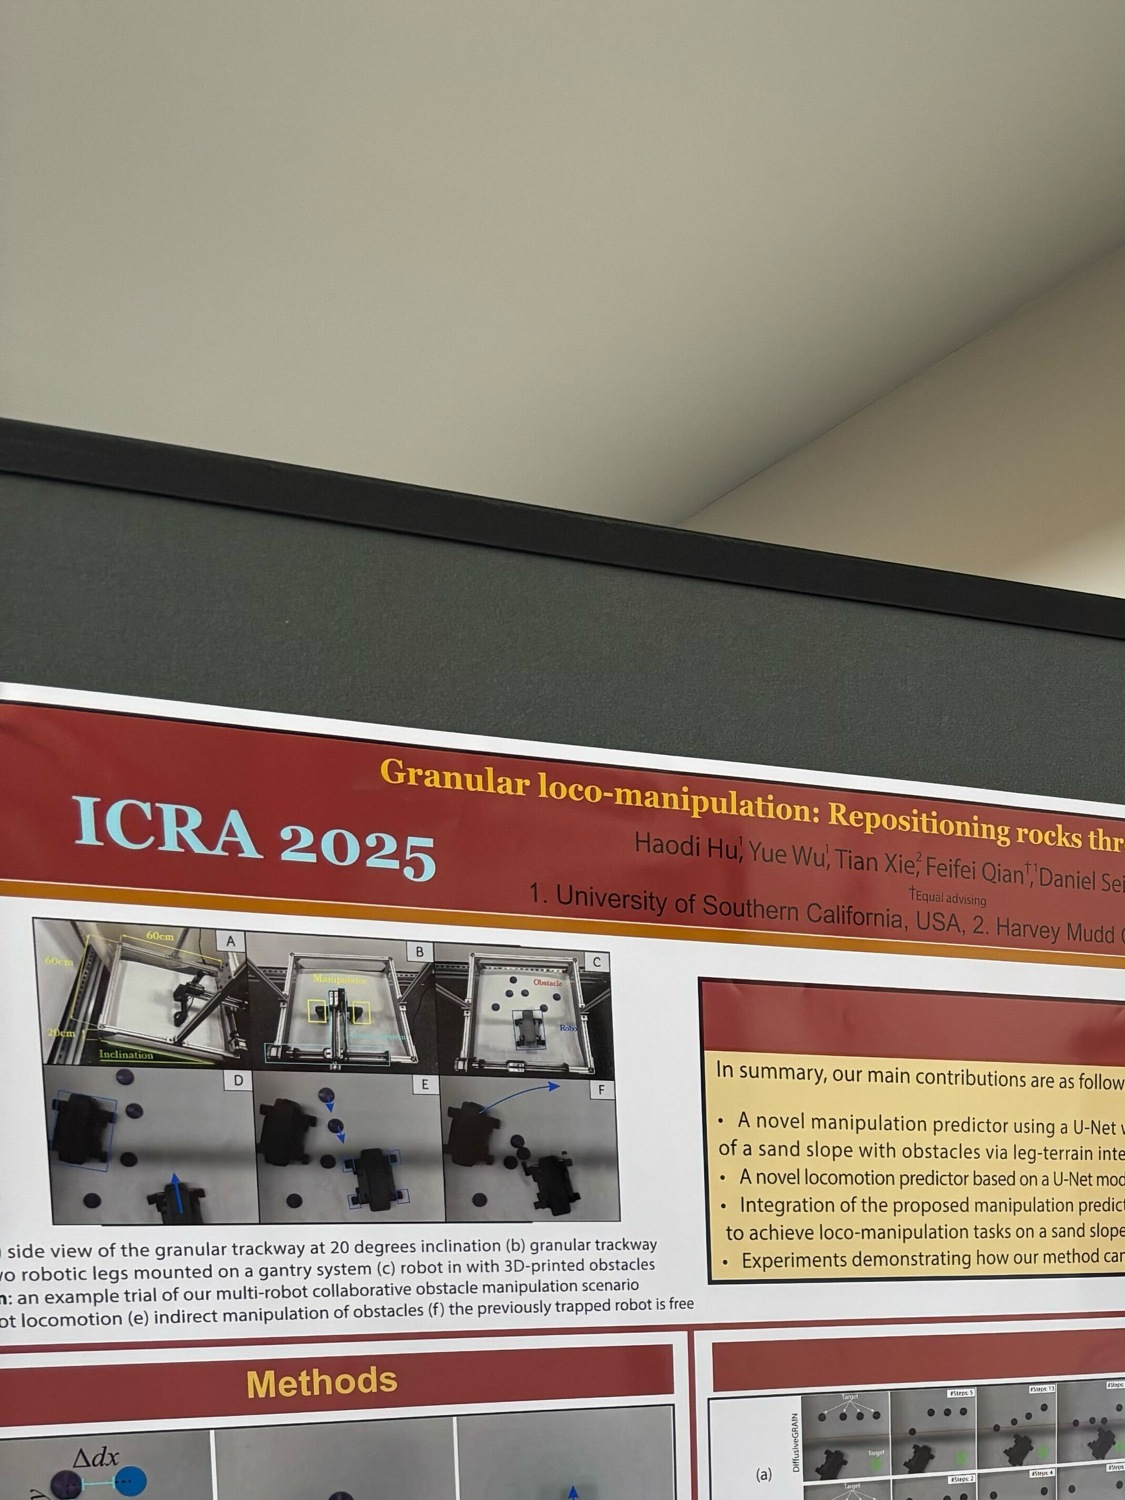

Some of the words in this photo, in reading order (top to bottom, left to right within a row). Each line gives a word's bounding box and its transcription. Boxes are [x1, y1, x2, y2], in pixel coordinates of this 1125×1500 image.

[381, 758, 531, 796] Granular
[539, 772, 821, 823] loco-manipulation:
[828, 802, 1011, 847] Repositioning
[1017, 824, 1083, 849] rocks
[72, 795, 264, 858] ICRA
[280, 826, 436, 882] 2025
[636, 831, 700, 857] Haodi
[749, 840, 787, 864] Yue
[835, 849, 878, 872] Tian
[927, 856, 976, 880] Feifei
[1040, 867, 1096, 891] Daniel
[946, 893, 987, 908] advising
[530, 882, 548, 903] 1.
[557, 884, 667, 916] University
[675, 893, 695, 914] of
[704, 896, 799, 921] Southern
[807, 903, 909, 931] California,
[917, 911, 966, 936] USA,
[973, 916, 990, 935] 2.
[997, 917, 1061, 944] Harvey
[1067, 923, 1115, 944] Mudd
[146, 931, 174, 941] 60cm
[226, 935, 236, 947] A
[416, 946, 424, 958] B
[593, 957, 601, 967] C
[99, 1049, 154, 1060] Inclination
[235, 1074, 243, 1086] D
[717, 1060, 733, 1078] In
[740, 1065, 828, 1085] summary,
[833, 1068, 862, 1082] our
[868, 1067, 910, 1083] main
[915, 1068, 1026, 1088] contributions
[1031, 1075, 1055, 1088] are
[1059, 1076, 1074, 1089] as
[422, 1079, 430, 1091] E
[599, 1085, 605, 1095] F
[17, 1291, 39, 1305] an
[45, 1289, 120, 1306] example
[124, 1288, 157, 1303] trial
[162, 1287, 179, 1301] of
[184, 1290, 211, 1301] our
[217, 1286, 308, 1300] multi-robot
[312, 1282, 412, 1299] collaborative
[416, 1281, 478, 1295] obstacle
[482, 1279, 578, 1296] manipulation
[582, 1279, 639, 1292] scenario
[247, 1366, 398, 1399] Methods
[792, 1413, 800, 1472] DiffusiveGRAIN
[756, 1468, 772, 1482] (a)
